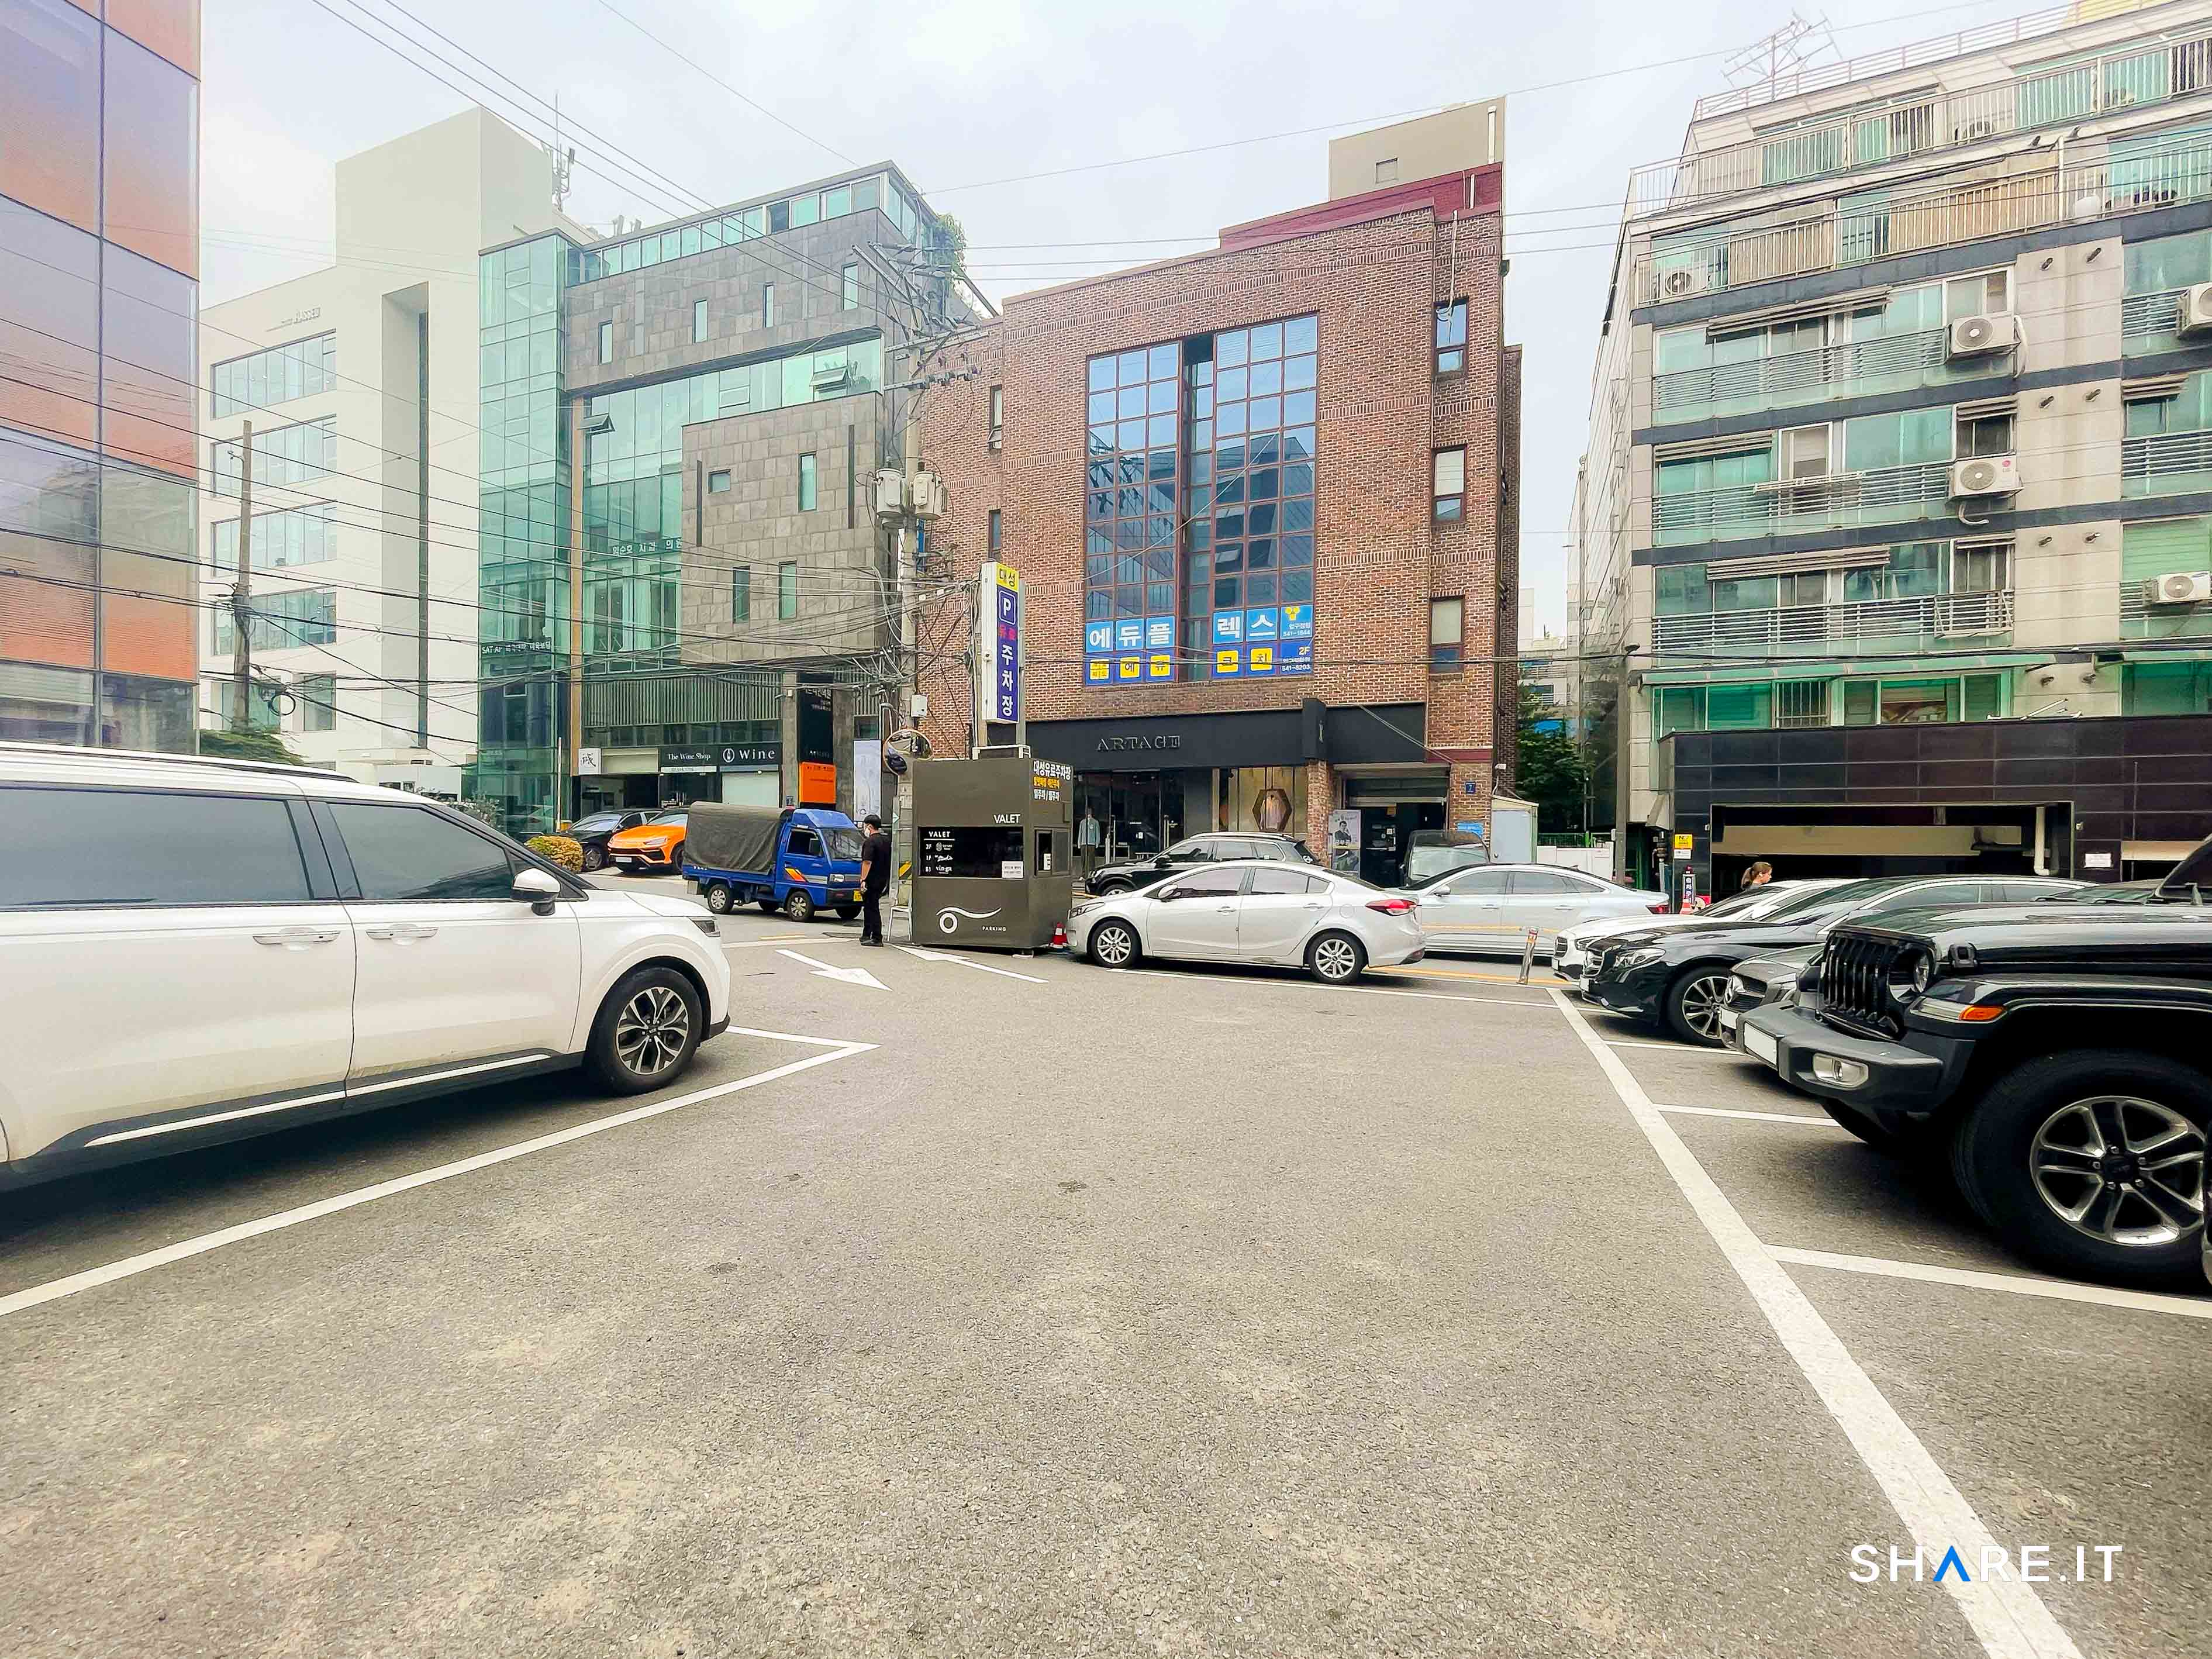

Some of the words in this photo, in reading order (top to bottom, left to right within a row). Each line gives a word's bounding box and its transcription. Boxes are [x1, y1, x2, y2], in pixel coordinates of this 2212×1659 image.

[999, 568, 1015, 587] 대성
[1003, 597, 1012, 616] P
[1299, 646, 1310, 656] 2F
[1001, 644, 1013, 716] 주차장
[696, 753, 711, 761] Shop
[739, 749, 775, 759] Wine
[1033, 760, 1071, 780] 대성유료주차장
[993, 813, 1020, 823] VALET
